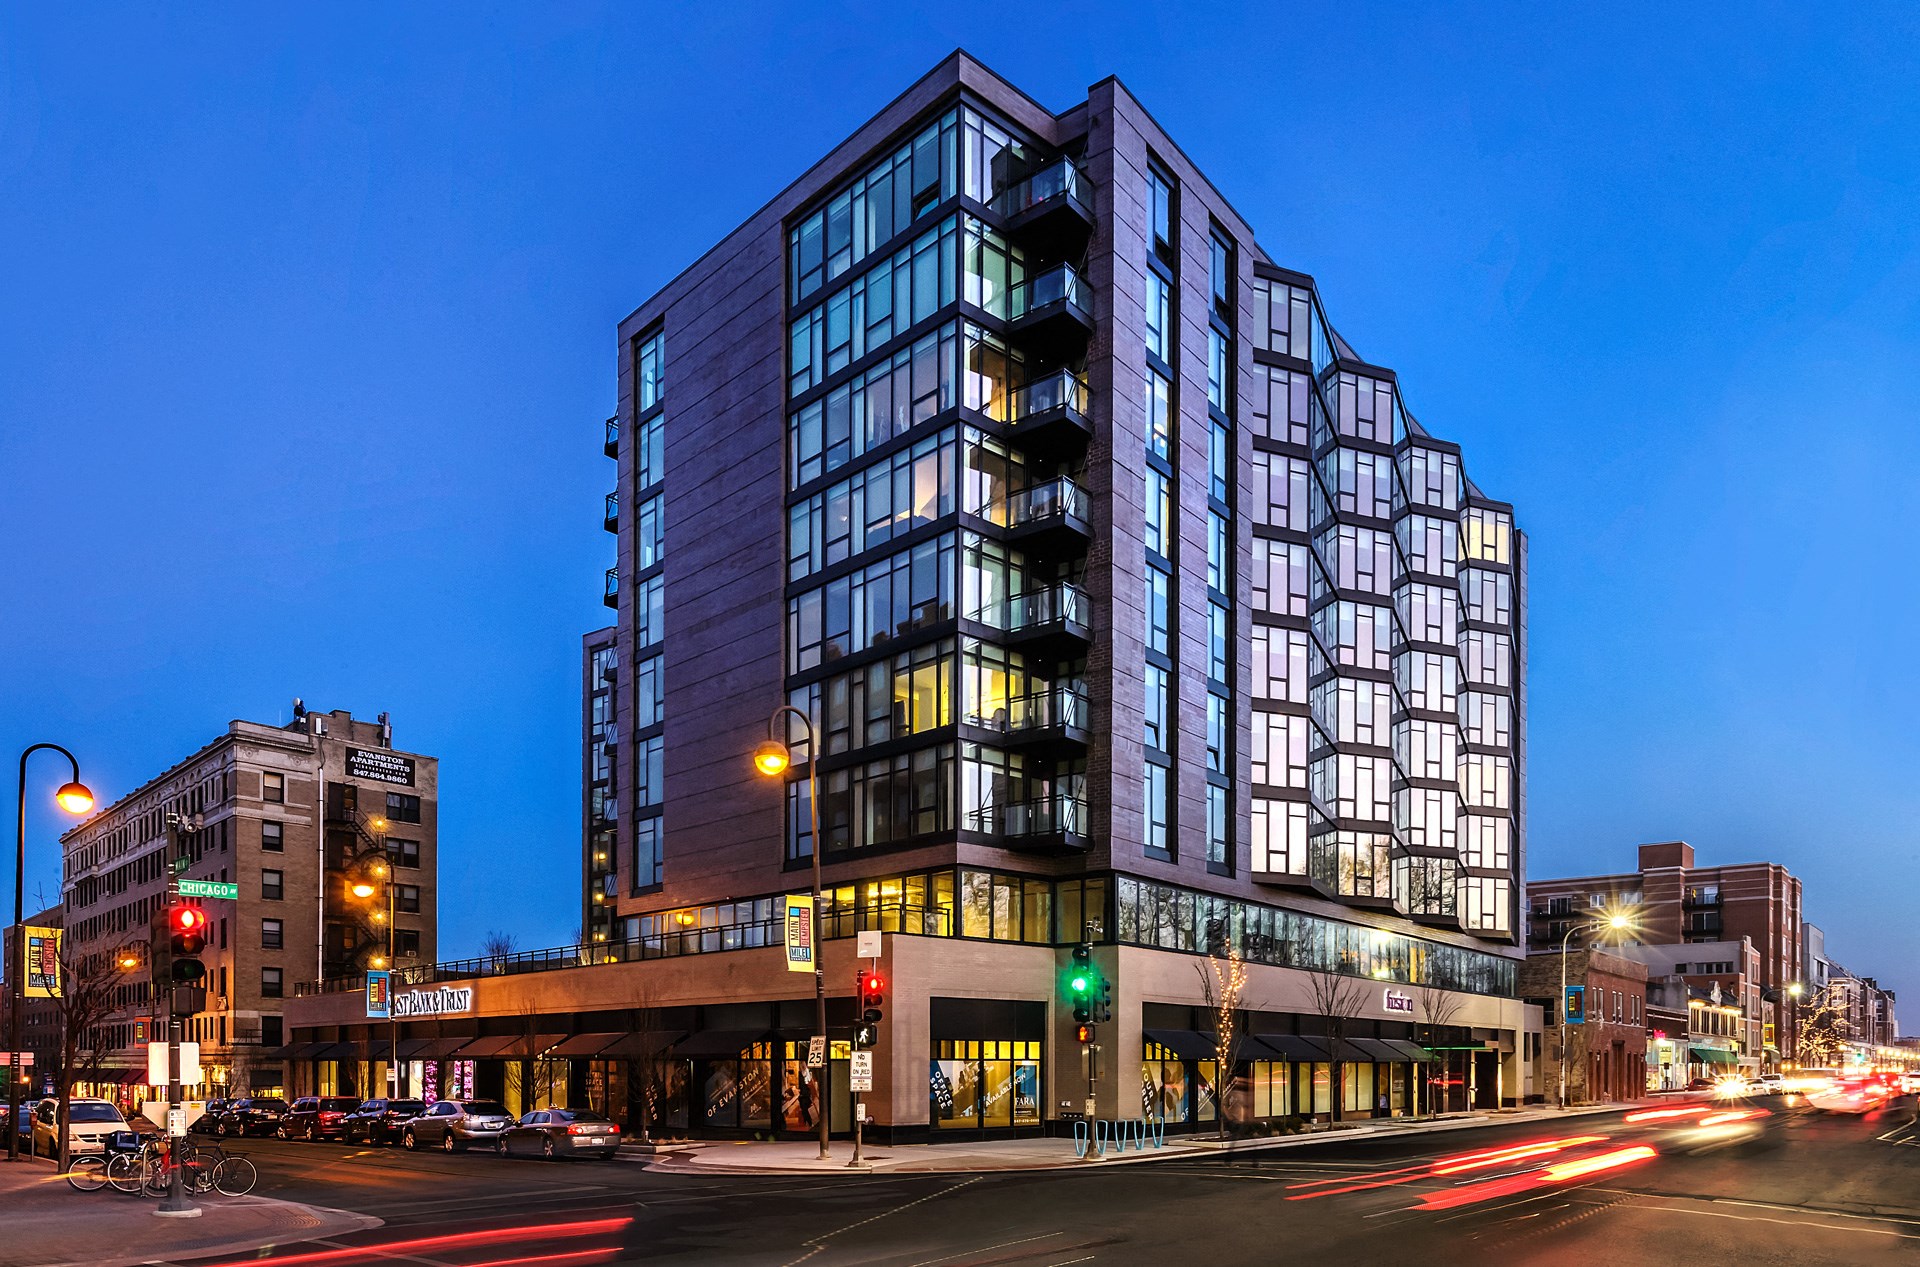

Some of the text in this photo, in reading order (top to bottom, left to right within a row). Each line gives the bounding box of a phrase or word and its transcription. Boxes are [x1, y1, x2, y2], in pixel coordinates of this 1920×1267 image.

[350, 756, 410, 772] APARTMENTS
[357, 750, 404, 765] EVANSTON
[180, 882, 228, 896] CHICAGO
[791, 920, 799, 940] MAIN
[790, 947, 806, 958] MILE
[439, 988, 470, 1013] TRUST
[809, 1053, 822, 1063] 25
[707, 1104, 717, 1117] OF
[719, 1067, 759, 1107] EVANSTON
[934, 1071, 953, 1107] OFFICE
[1141, 1064, 1154, 1099] YOUR
[930, 1077, 947, 1109] SPACE
[985, 1082, 1013, 1107] AVAILABLE
